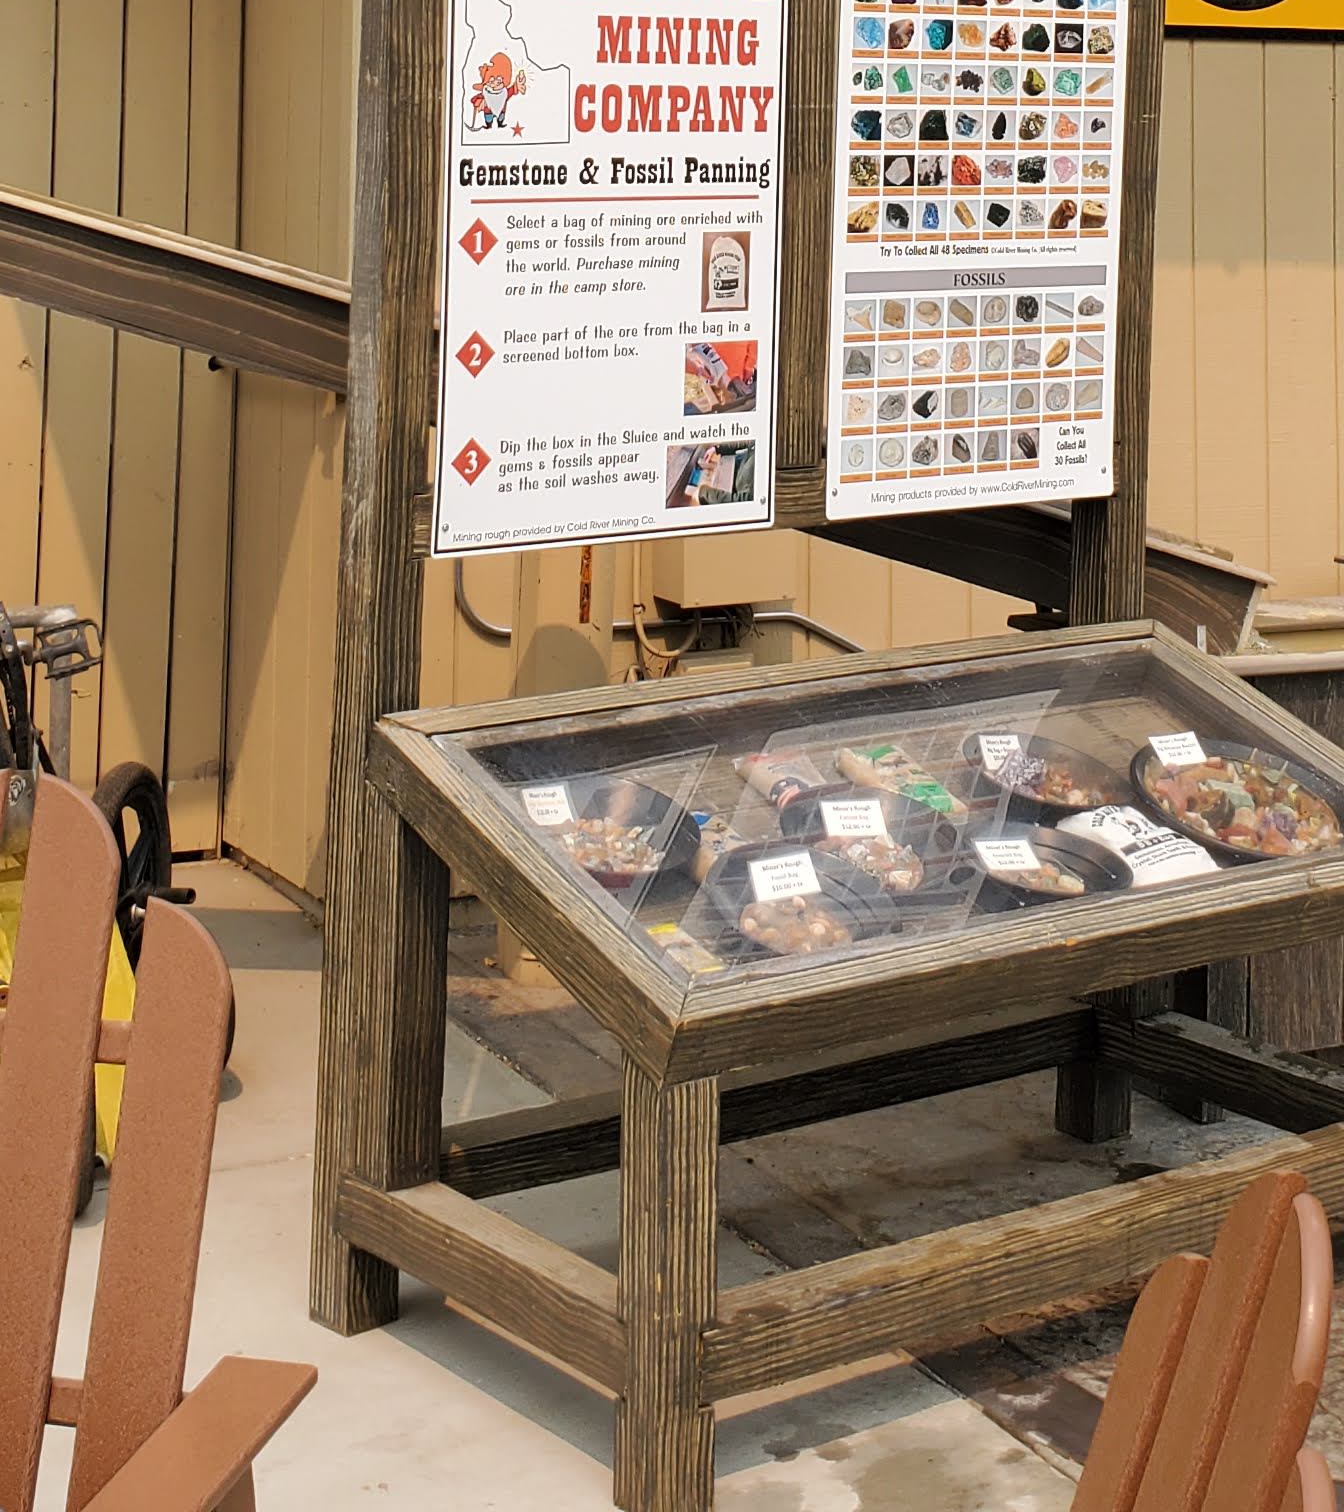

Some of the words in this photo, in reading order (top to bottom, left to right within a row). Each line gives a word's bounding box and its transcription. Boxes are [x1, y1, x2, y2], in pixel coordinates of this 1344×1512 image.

[596, 15, 759, 66] MINING
[573, 83, 774, 133] COMPANY
[459, 158, 567, 186] Gemstone
[579, 157, 599, 184] &
[610, 156, 673, 184] Fossil
[684, 156, 770, 188] Panning
[506, 215, 545, 229] Select
[551, 219, 557, 227] a
[563, 214, 585, 231] bag
[591, 212, 604, 226] of
[609, 214, 651, 229] mining
[656, 216, 675, 225] ore
[680, 210, 731, 225] enriched
[736, 210, 762, 223] with
[473, 230, 483, 253] 1
[506, 239, 539, 253] gems
[545, 239, 558, 248] or
[563, 233, 604, 248] fossils
[610, 232, 639, 246] from
[645, 231, 686, 245] around
[879, 246, 891, 257] Try
[893, 245, 902, 256] To
[904, 245, 927, 255] Collect
[929, 244, 938, 255] All
[940, 244, 950, 255] 48
[952, 244, 988, 255] Specimens
[506, 258, 526, 272] the
[532, 257, 570, 272] world.
[576, 255, 633, 270] Purchase
[638, 255, 679, 270] mining
[505, 285, 525, 295] ore
[530, 282, 542, 295] in
[549, 279, 568, 294] the
[574, 282, 606, 295] camp
[611, 278, 645, 291] store.
[954, 272, 1005, 286] FOSSILS
[503, 329, 536, 343] Place
[542, 327, 568, 345] part
[574, 325, 587, 339] of
[594, 324, 613, 339] the
[618, 327, 637, 337] ore
[643, 322, 672, 336] from
[679, 321, 697, 334] the
[702, 320, 723, 336] bag
[728, 320, 738, 332] in
[743, 322, 750, 331] a
[468, 343, 483, 368] 2
[503, 346, 559, 363] screened
[564, 345, 608, 360] bottom
[614, 343, 638, 357] box.
[500, 440, 520, 456] Dip
[527, 437, 546, 451] the
[552, 435, 574, 449] box
[580, 435, 591, 447] in
[597, 431, 616, 445] the
[622, 429, 657, 444] Sluice
[663, 426, 684, 440] and
[689, 423, 725, 439] watch
[731, 422, 749, 436] the
[464, 450, 480, 476] 3
[498, 461, 532, 477] gems
[552, 453, 592, 469] fossils
[598, 453, 639, 466] appear
[498, 482, 512, 492] as
[519, 476, 538, 491] the
[544, 473, 566, 488] soil
[571, 470, 618, 486] washes
[623, 470, 659, 483] away.
[870, 492, 895, 503] Mining
[898, 489, 932, 502] products
[934, 485, 966, 499] provided
[969, 485, 978, 496] by
